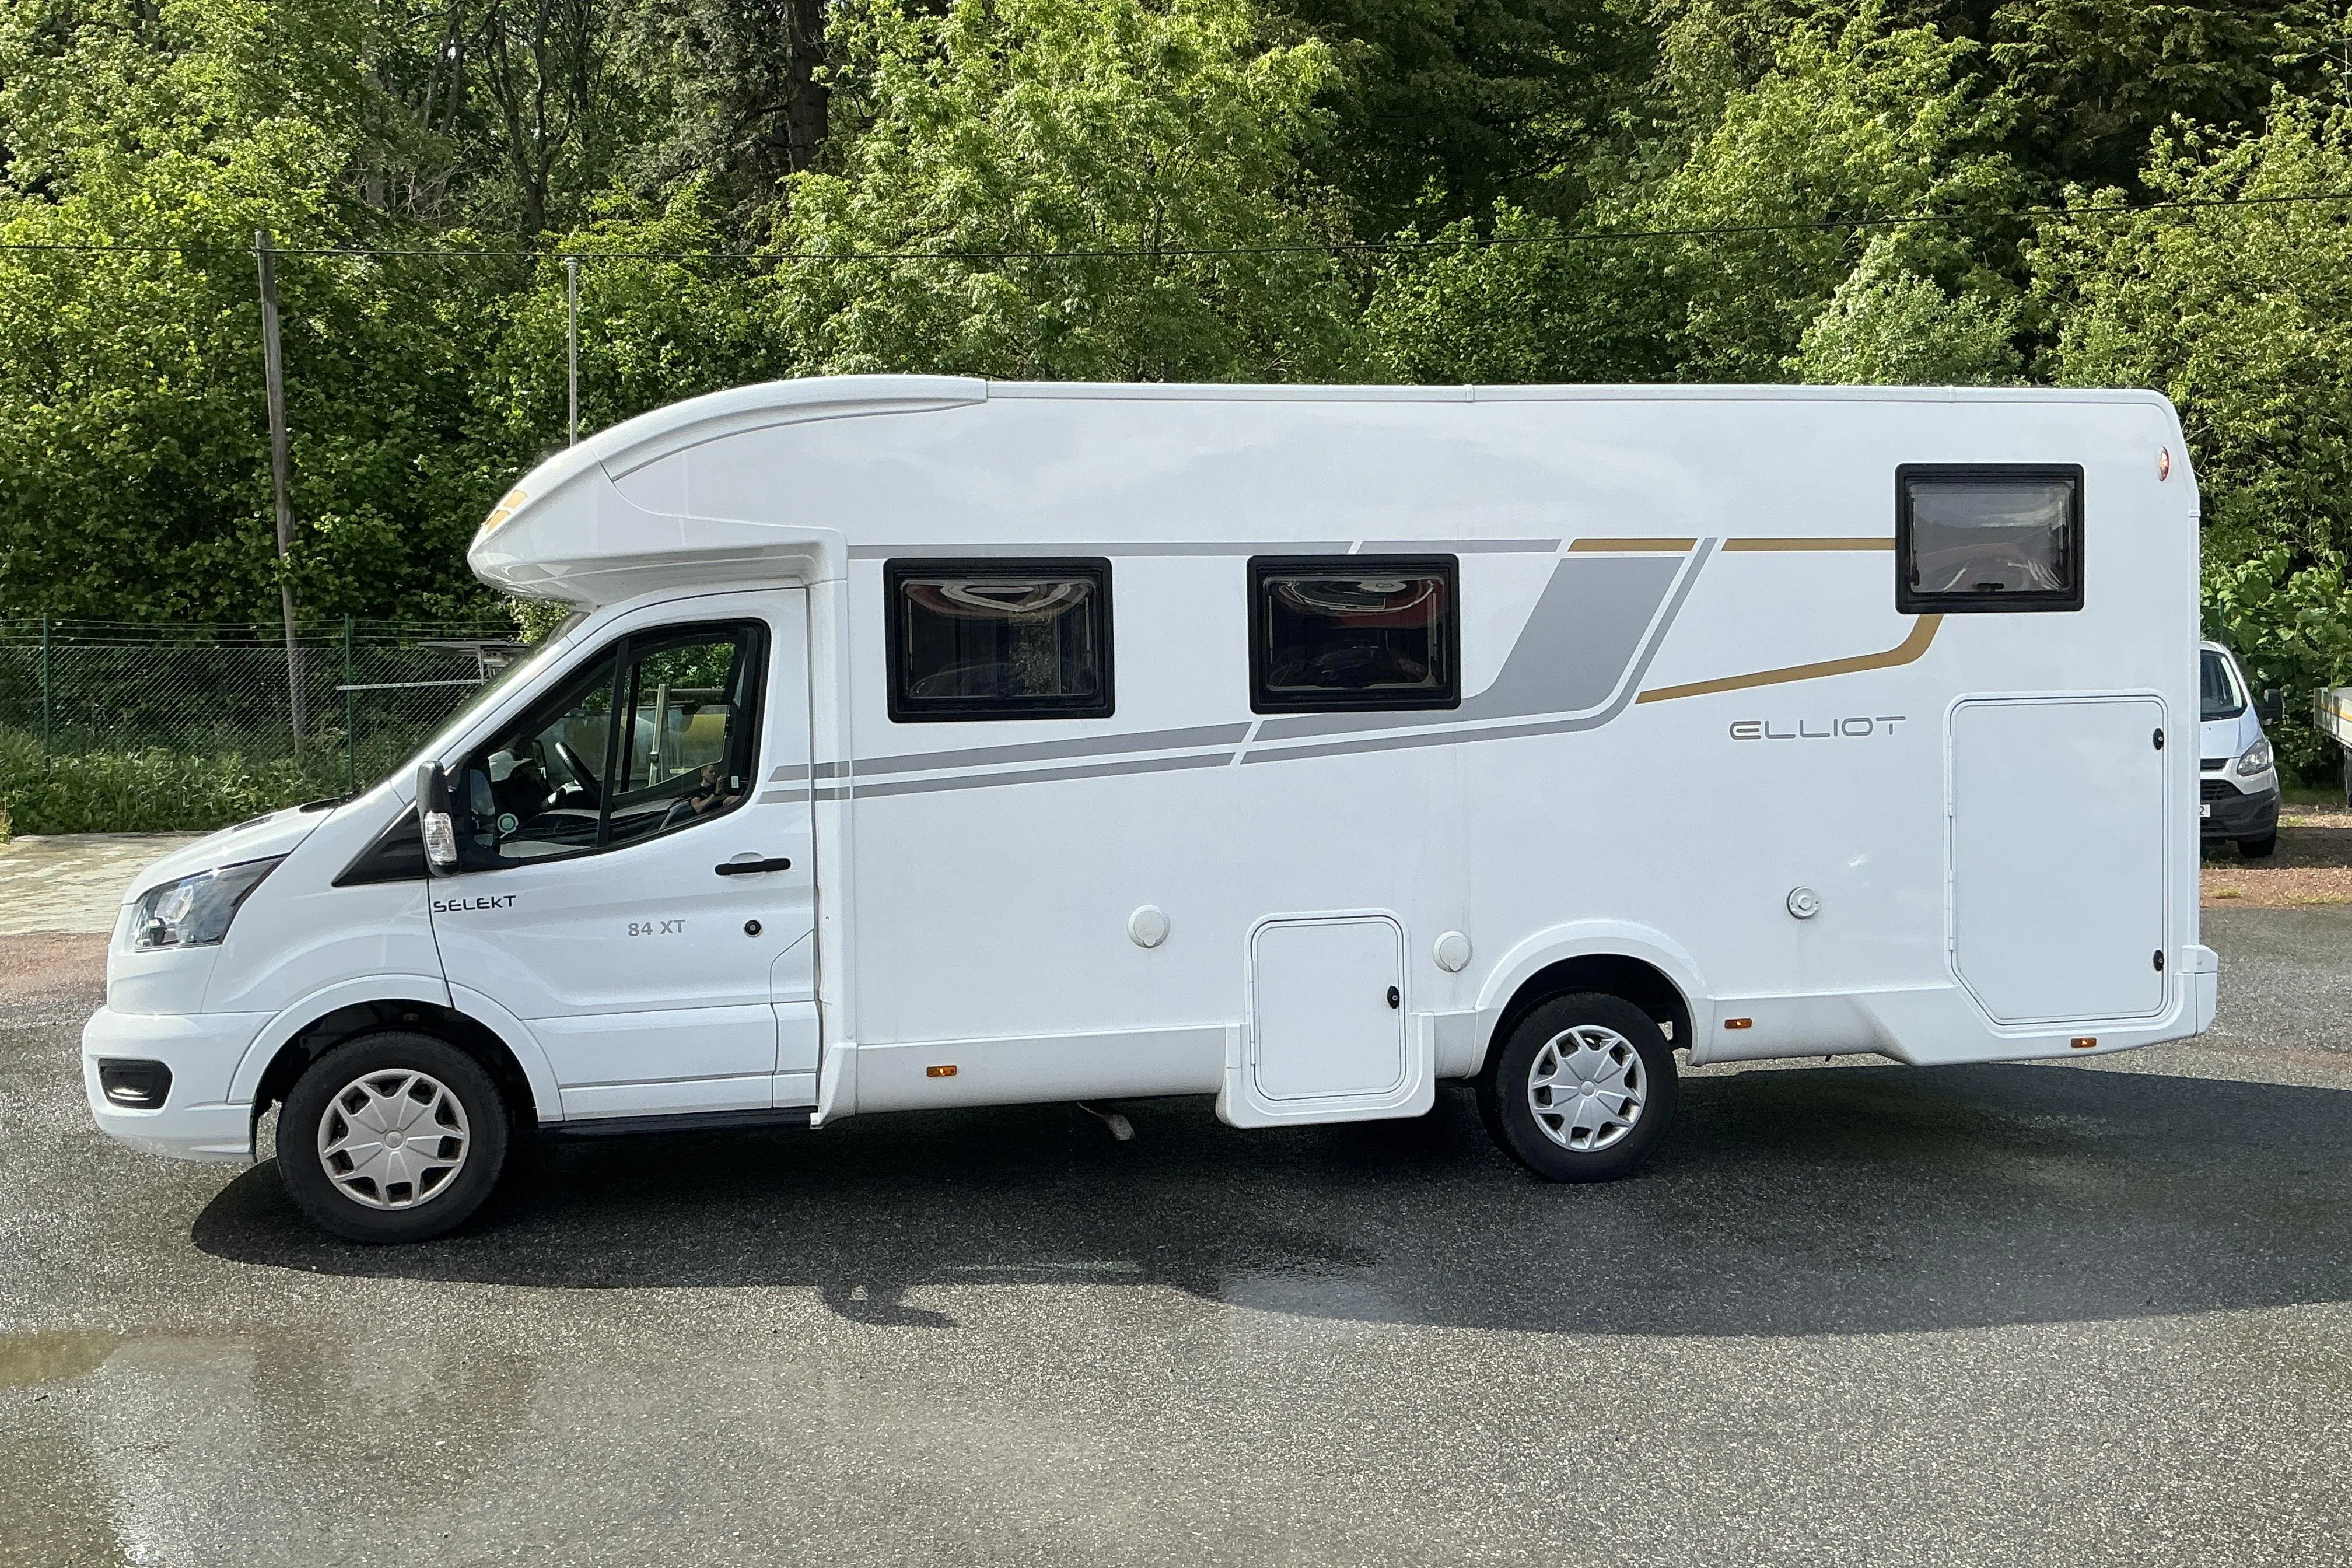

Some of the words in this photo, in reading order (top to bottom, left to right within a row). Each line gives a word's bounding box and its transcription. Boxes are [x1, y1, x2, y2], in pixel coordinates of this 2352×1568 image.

[1729, 716, 1906, 740] ELLIOT
[433, 895, 517, 914] SELEKT
[628, 922, 653, 937] 84
[659, 919, 686, 935] XT
